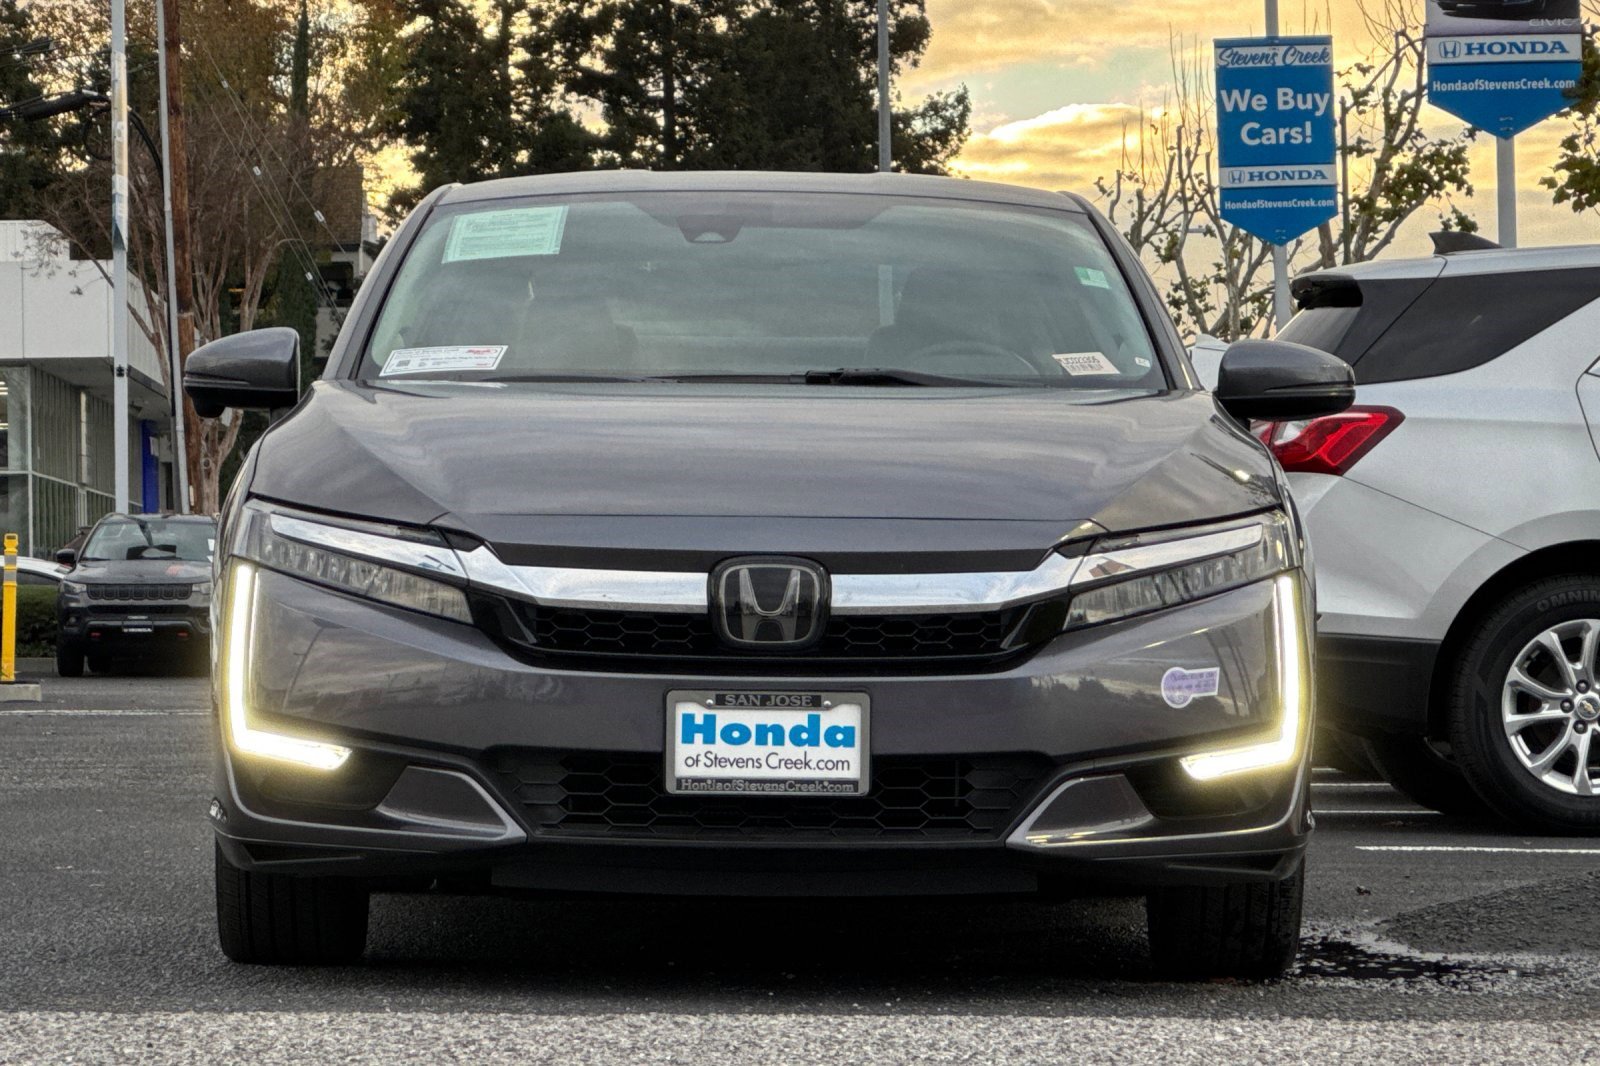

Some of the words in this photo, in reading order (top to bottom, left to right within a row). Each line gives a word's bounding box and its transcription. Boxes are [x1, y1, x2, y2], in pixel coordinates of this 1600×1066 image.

[1529, 18, 1574, 27] CIVIC
[1464, 40, 1569, 56] HONDA
[1217, 47, 1279, 67] Stevens
[1282, 45, 1331, 65] Creek
[1432, 77, 1576, 92] HondaofStevensCreek.com
[1220, 88, 1268, 112] We
[1277, 87, 1330, 116] Buy
[1240, 121, 1312, 145] Cars!
[1247, 169, 1329, 182] HONDA
[1224, 197, 1335, 210] HondaofStevensCreek.com
[724, 694, 760, 707] SAN
[765, 694, 813, 707] JOSE
[681, 713, 856, 748] Honda
[684, 752, 702, 768] of
[703, 751, 762, 769] Stevens
[765, 751, 850, 771] Creek.com
[681, 779, 854, 793] HondaofStevensCreek.com
